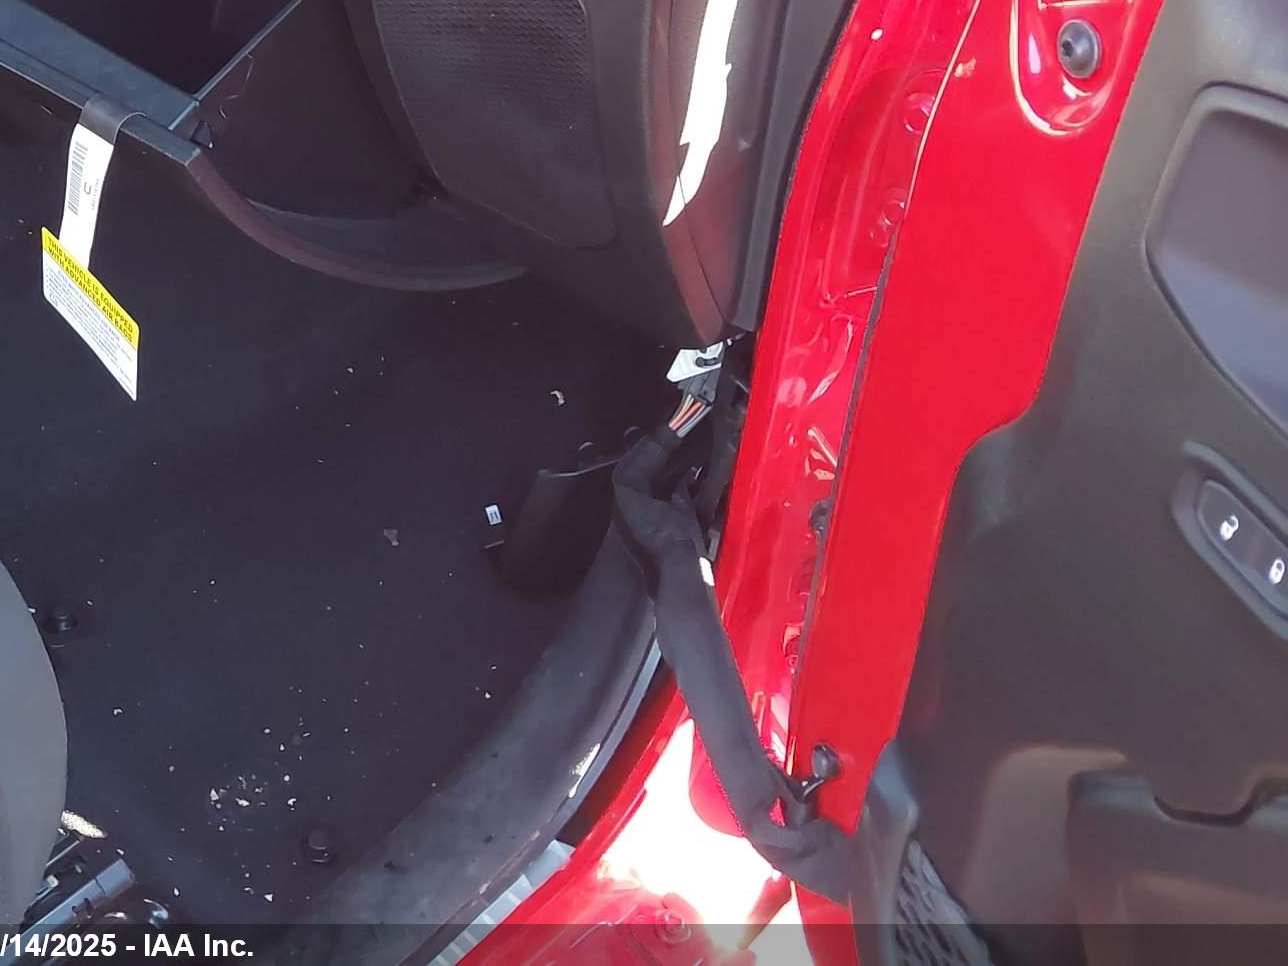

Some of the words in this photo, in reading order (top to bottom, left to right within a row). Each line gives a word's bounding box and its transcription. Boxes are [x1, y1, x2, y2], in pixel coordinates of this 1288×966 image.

[48, 236, 62, 257] THIS
[63, 252, 93, 287] VEHICLE
[101, 292, 133, 333] EQUIPPED
[48, 245, 64, 268] WITH
[65, 265, 101, 307] ADVANCED
[102, 306, 113, 322] AIR
[114, 318, 133, 343] BAGS
